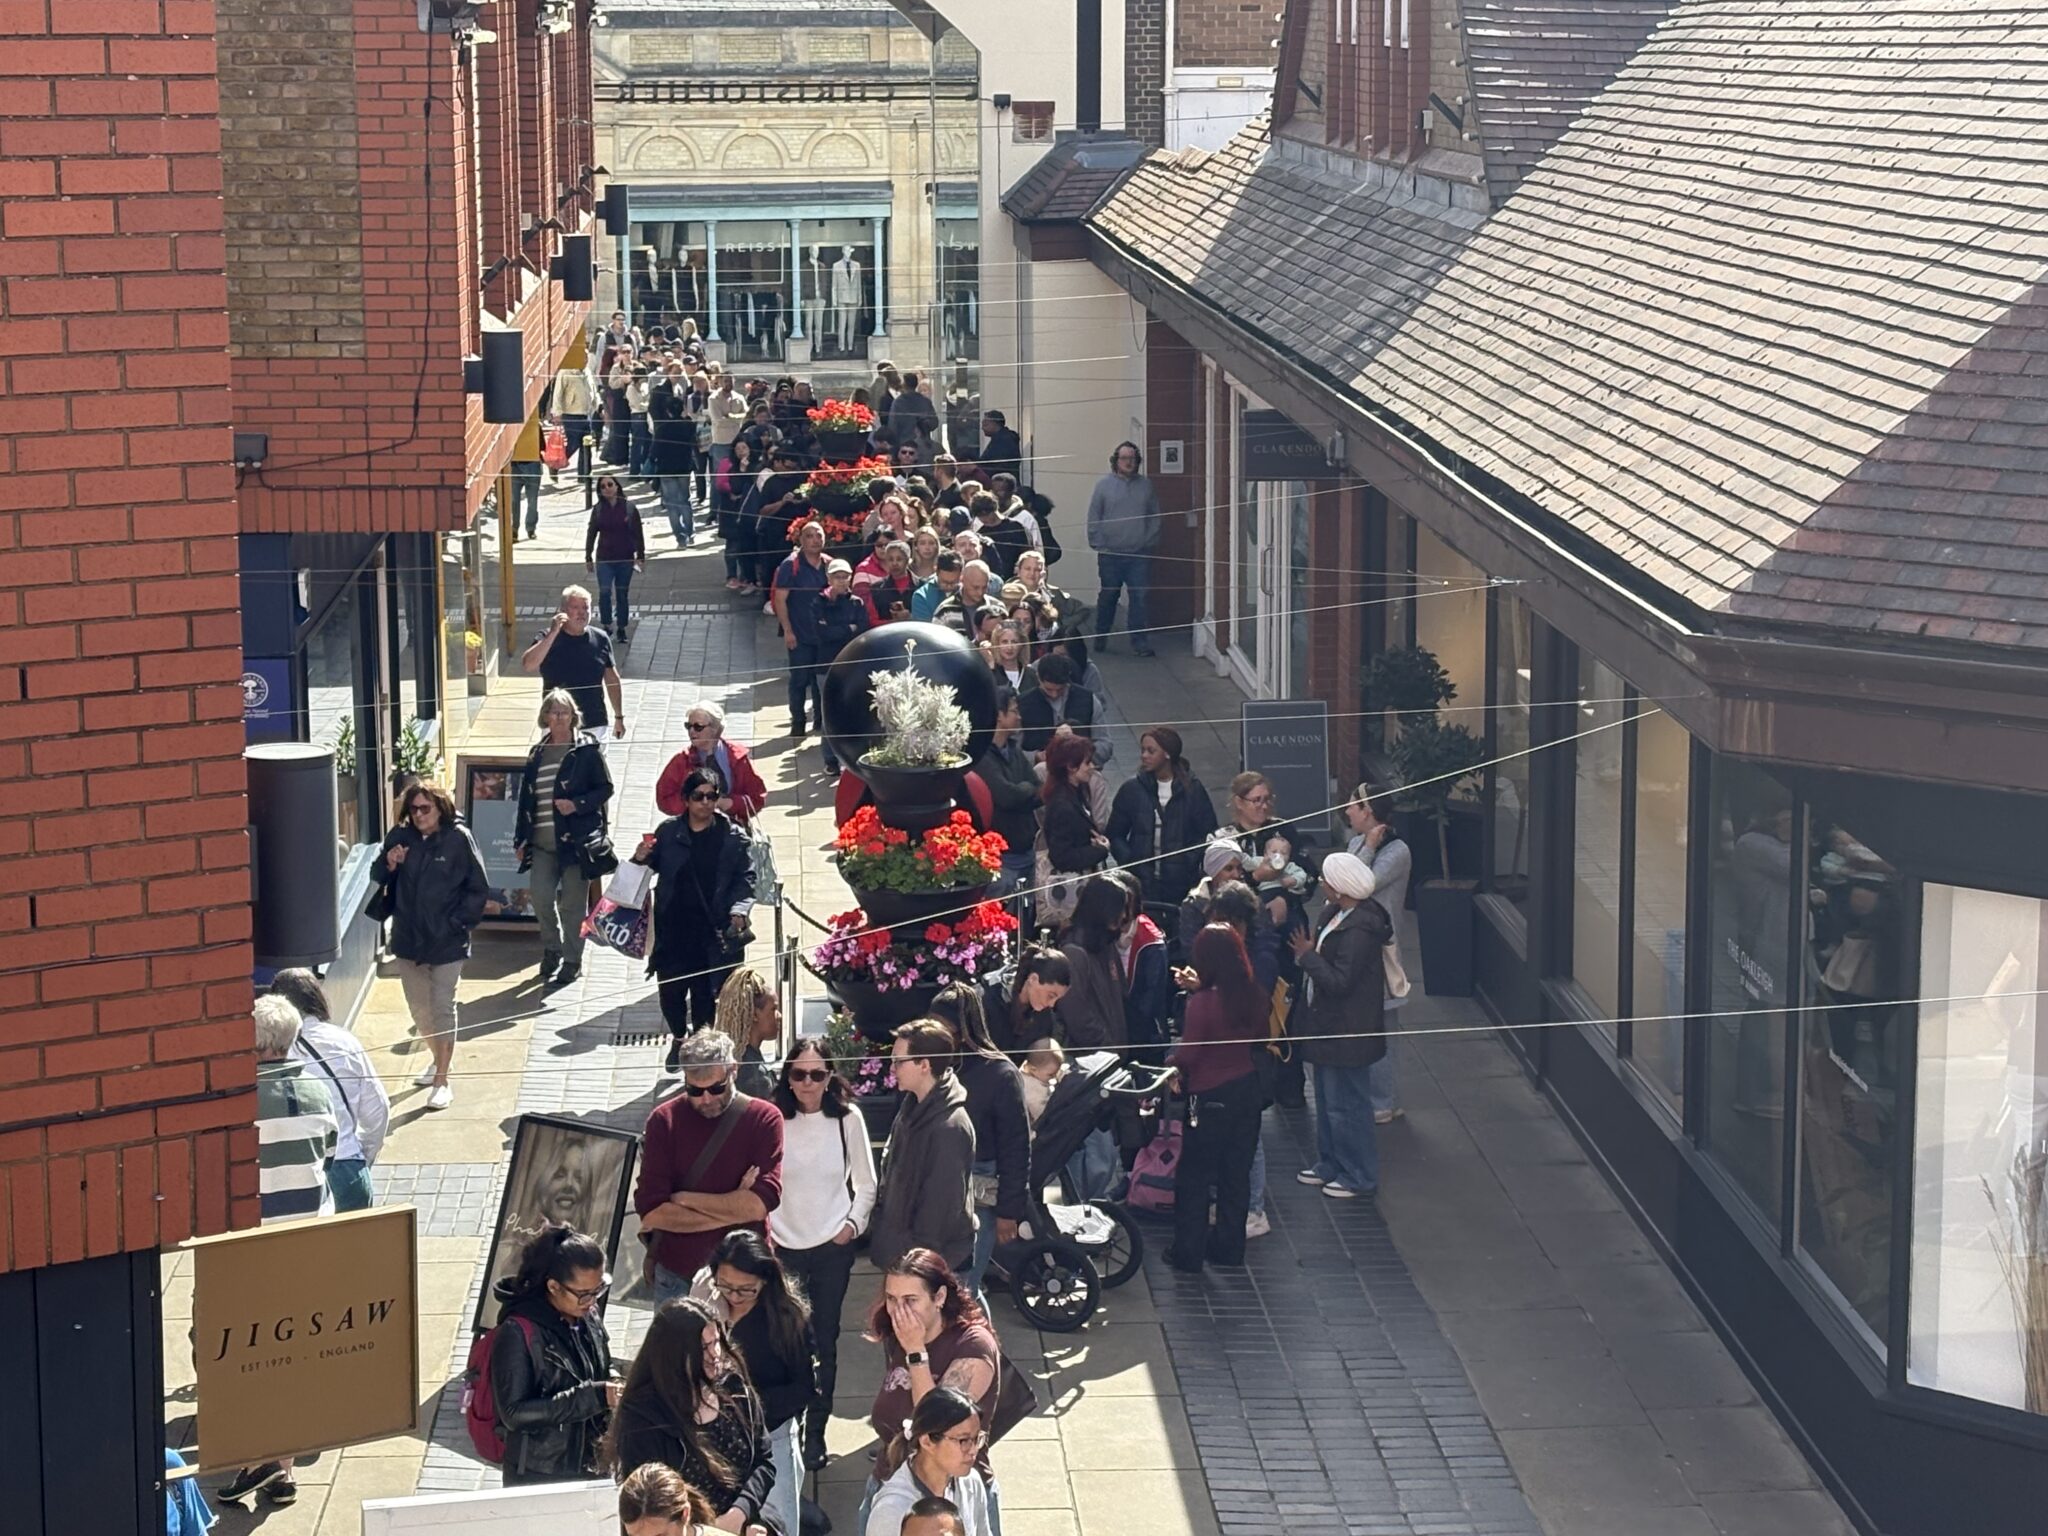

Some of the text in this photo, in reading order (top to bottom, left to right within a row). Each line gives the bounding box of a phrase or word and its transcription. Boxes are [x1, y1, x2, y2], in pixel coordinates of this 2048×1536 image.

[726, 242, 775, 253] REISS
[1252, 444, 1322, 457] CLARENDO
[1249, 734, 1322, 747] CLARENDON
[213, 1299, 396, 1361] JIGSAW
[240, 1361, 260, 1374] EST
[265, 1356, 292, 1370] 1970
[319, 1341, 375, 1360] ENGLAND
